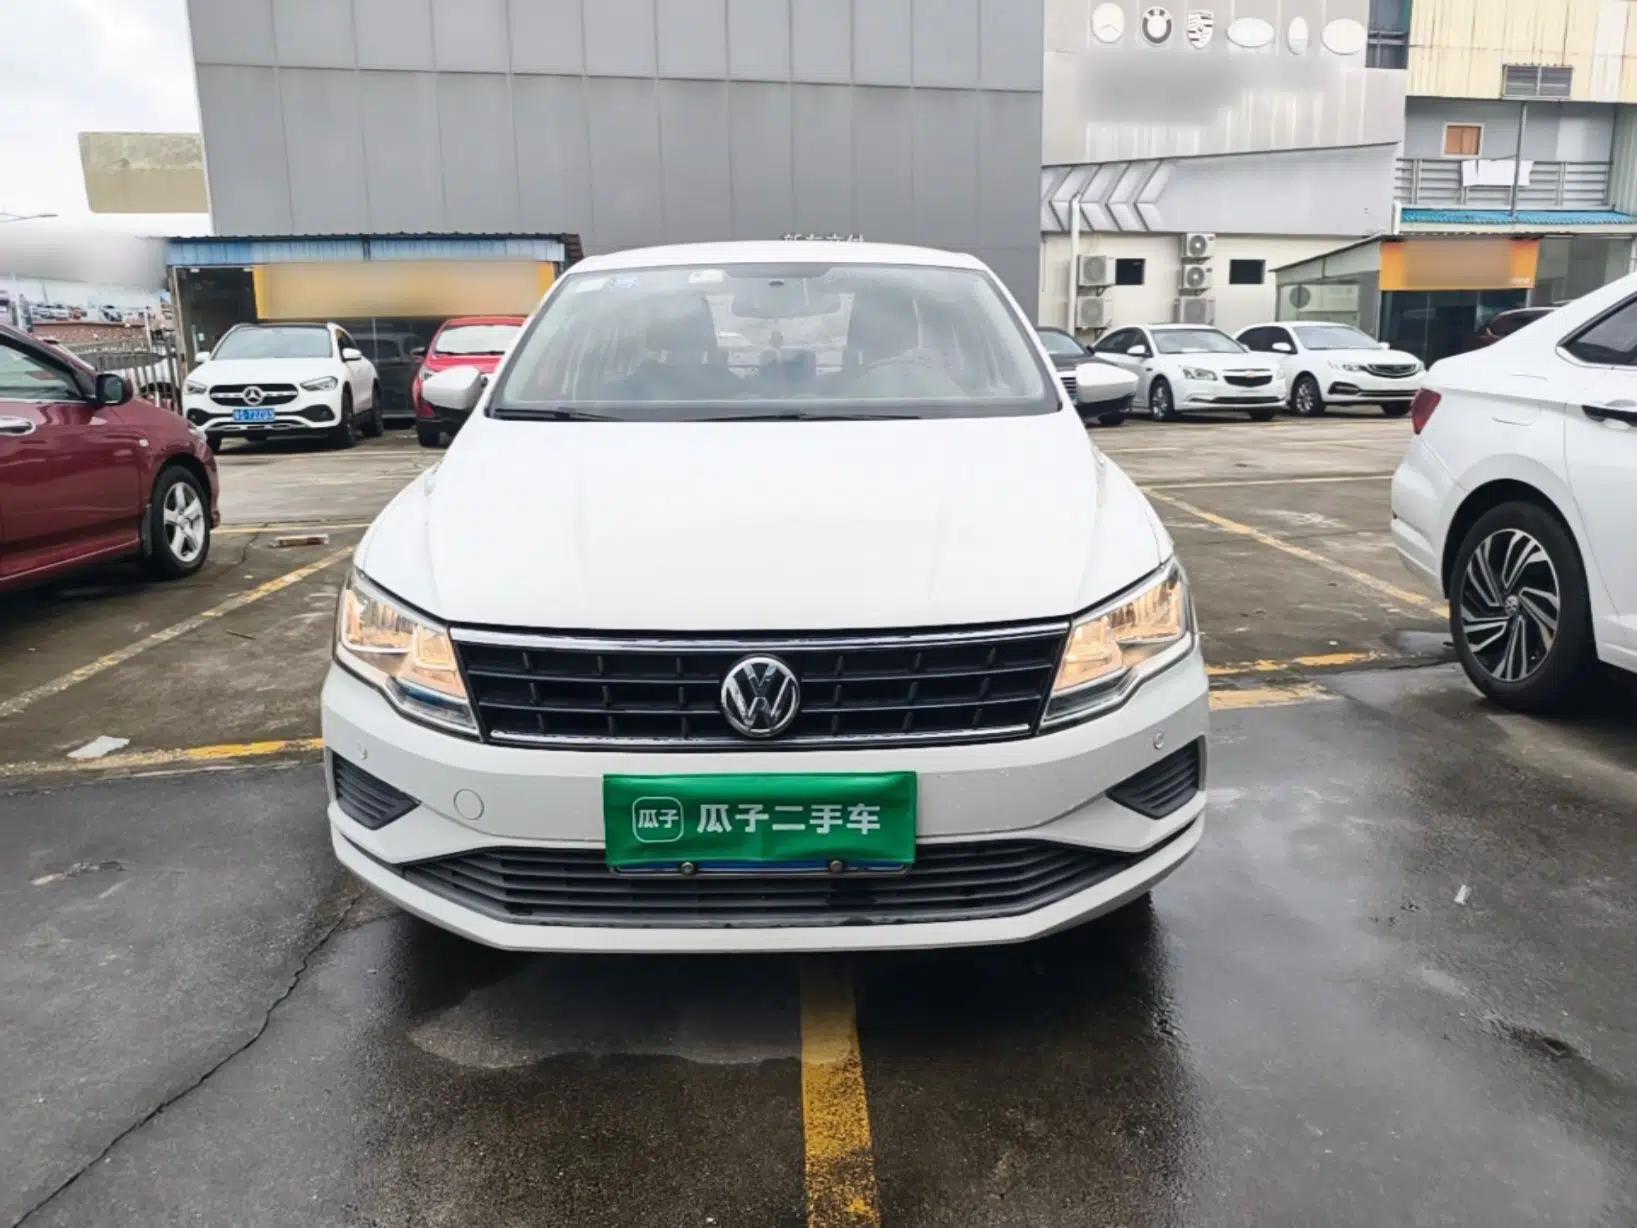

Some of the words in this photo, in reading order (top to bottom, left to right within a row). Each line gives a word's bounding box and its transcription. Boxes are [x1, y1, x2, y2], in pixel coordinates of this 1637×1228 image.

[722, 657, 797, 734] VW
[638, 808, 679, 829] 瓜子
[696, 802, 881, 835] 瓜子二手车
